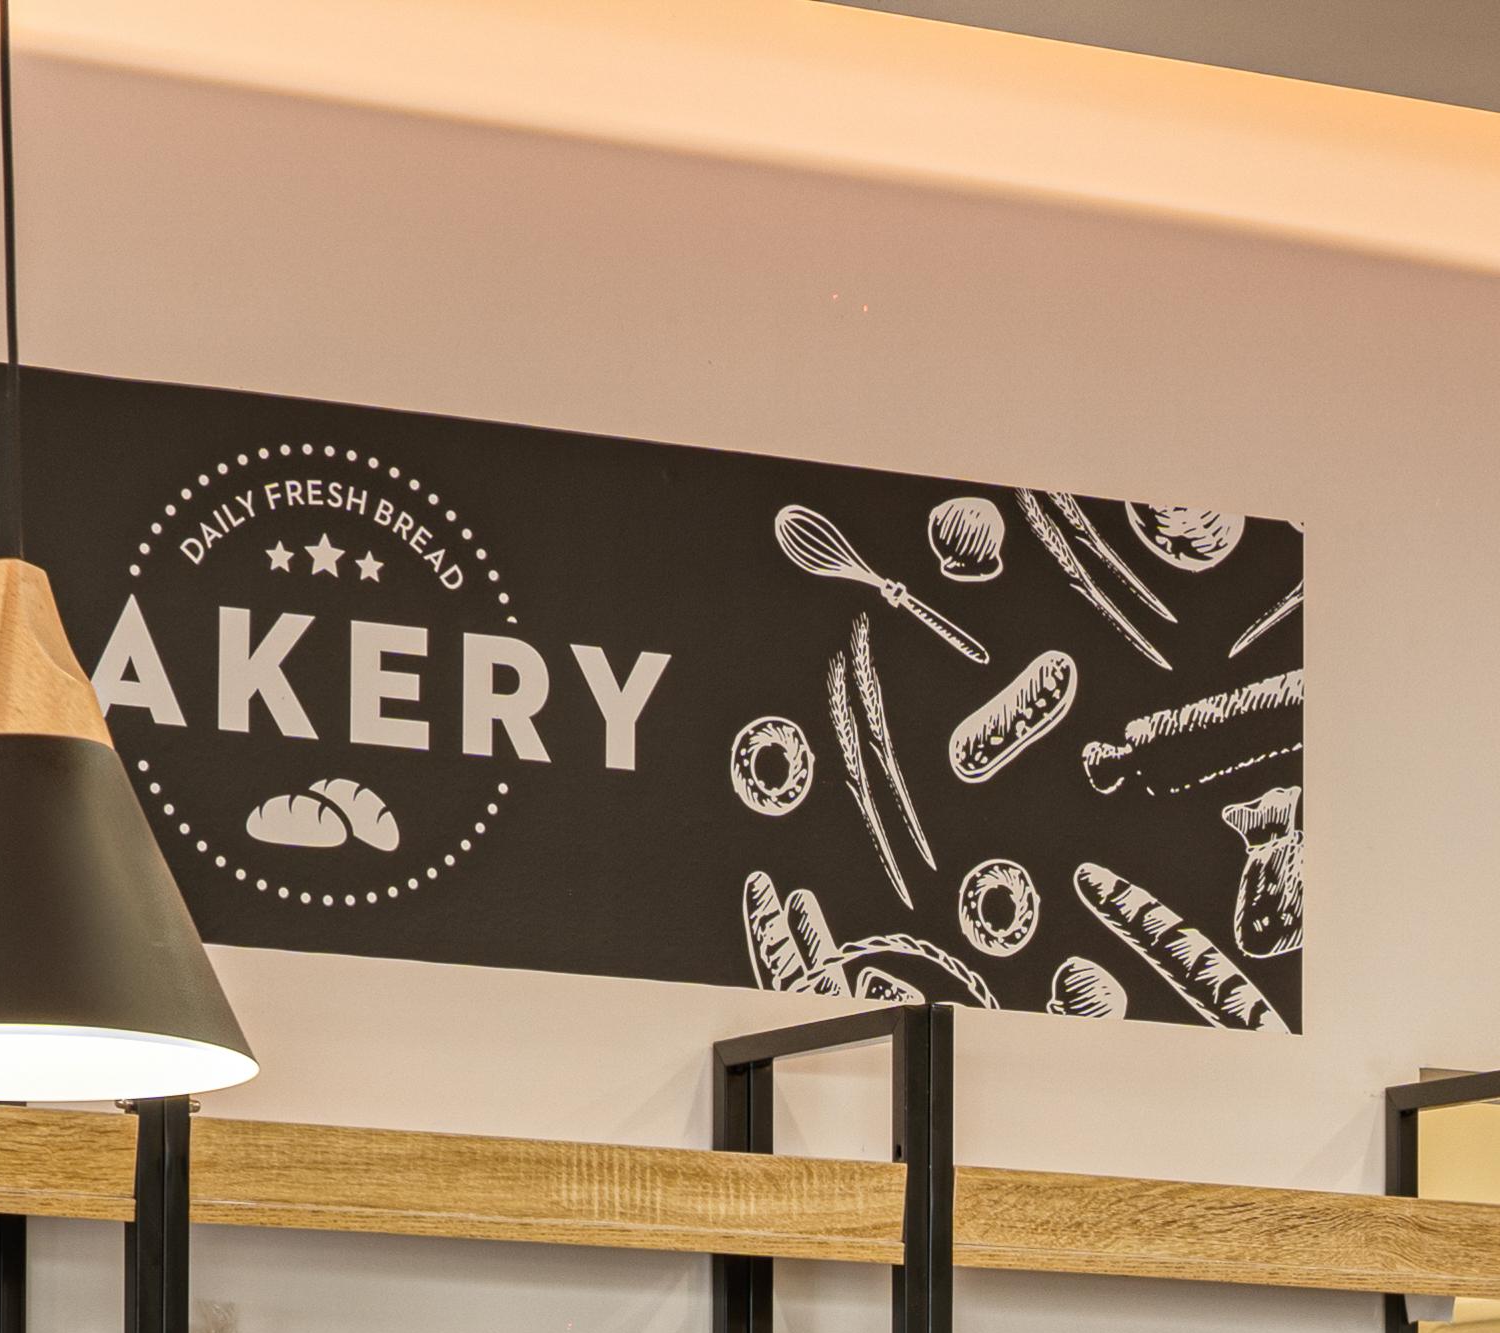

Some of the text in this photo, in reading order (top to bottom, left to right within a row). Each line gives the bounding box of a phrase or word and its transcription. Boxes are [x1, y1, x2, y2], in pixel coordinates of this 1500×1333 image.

[180, 480, 464, 592] DAILY FRESH BREAD
